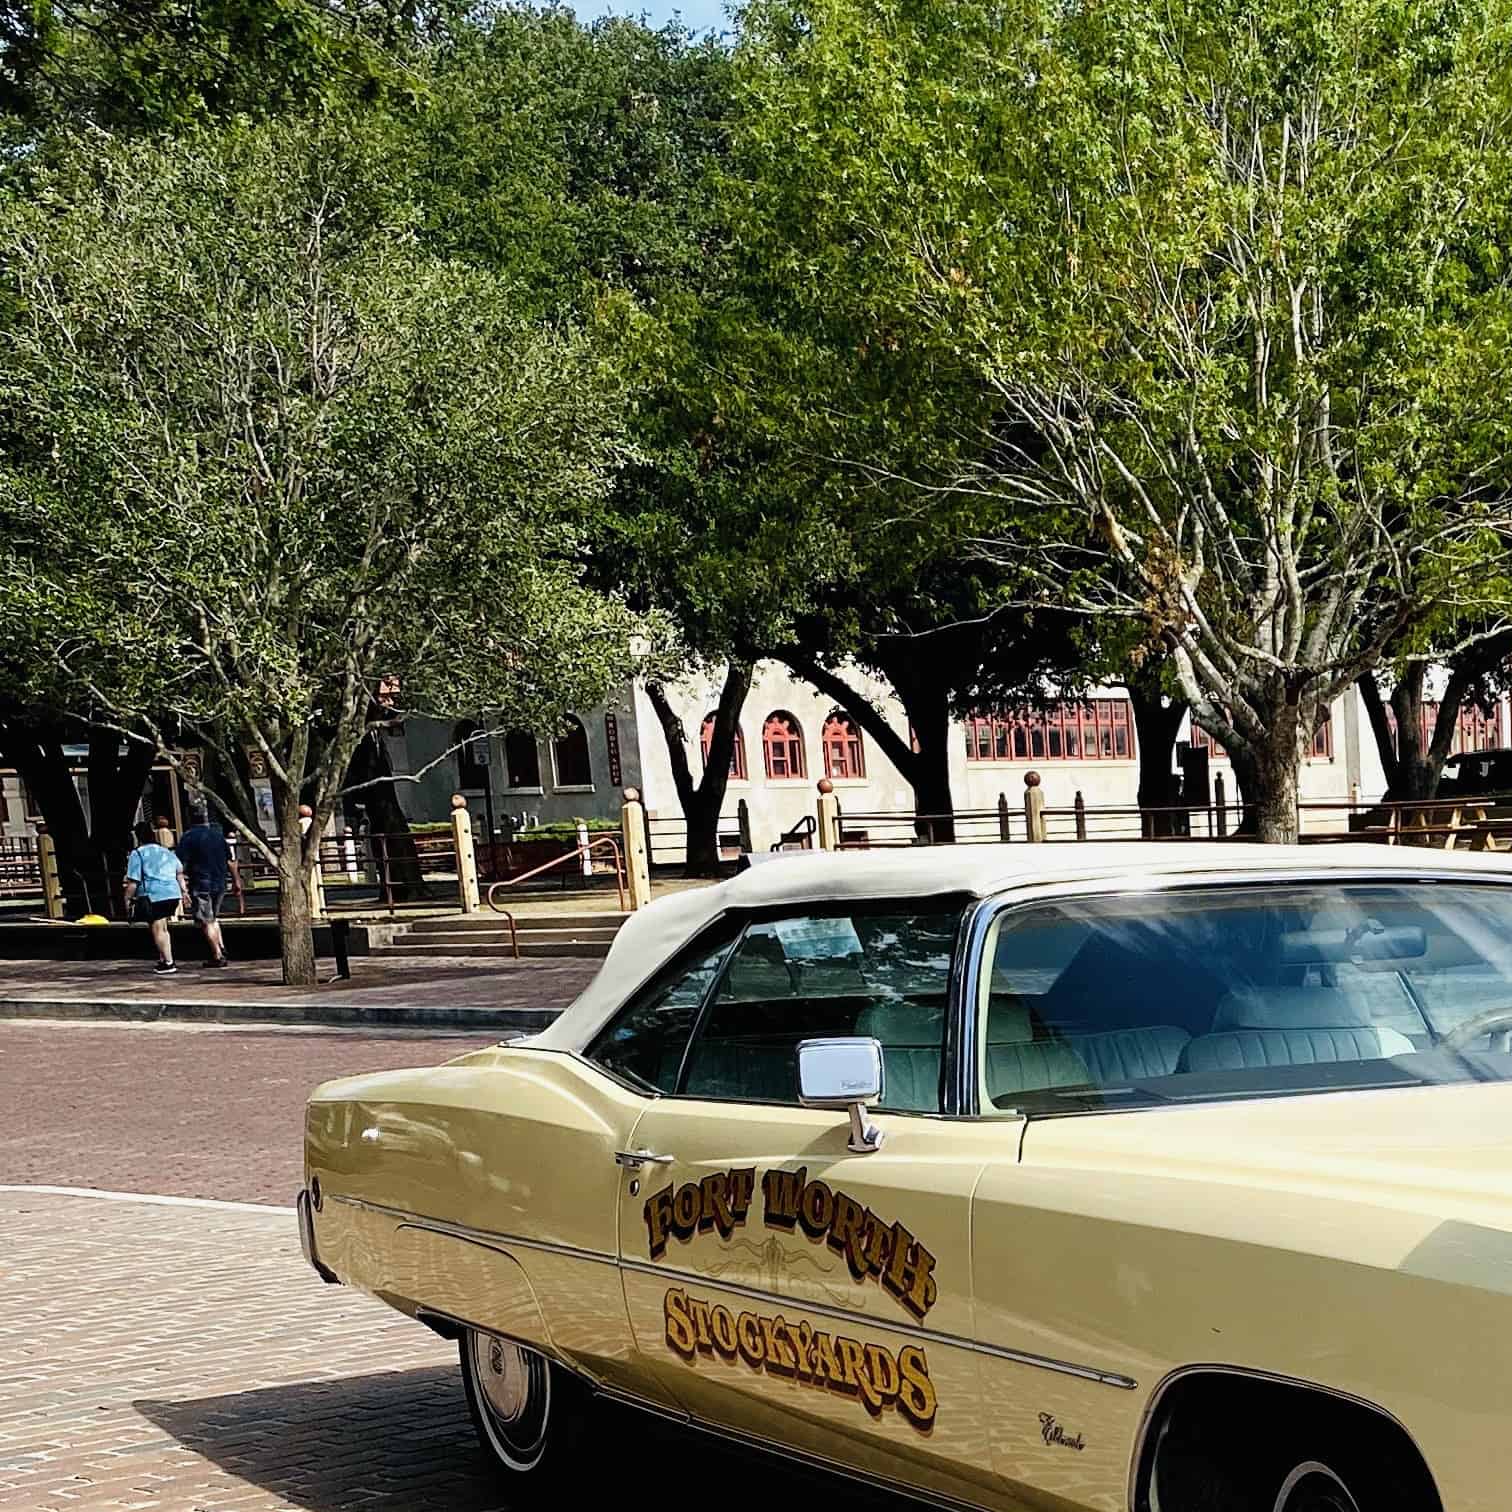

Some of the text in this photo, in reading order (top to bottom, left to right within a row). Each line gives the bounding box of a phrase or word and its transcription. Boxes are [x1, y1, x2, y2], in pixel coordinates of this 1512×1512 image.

[643, 1166, 938, 1327] FORT WORTH
[663, 1287, 938, 1438] STOCKYARDS
